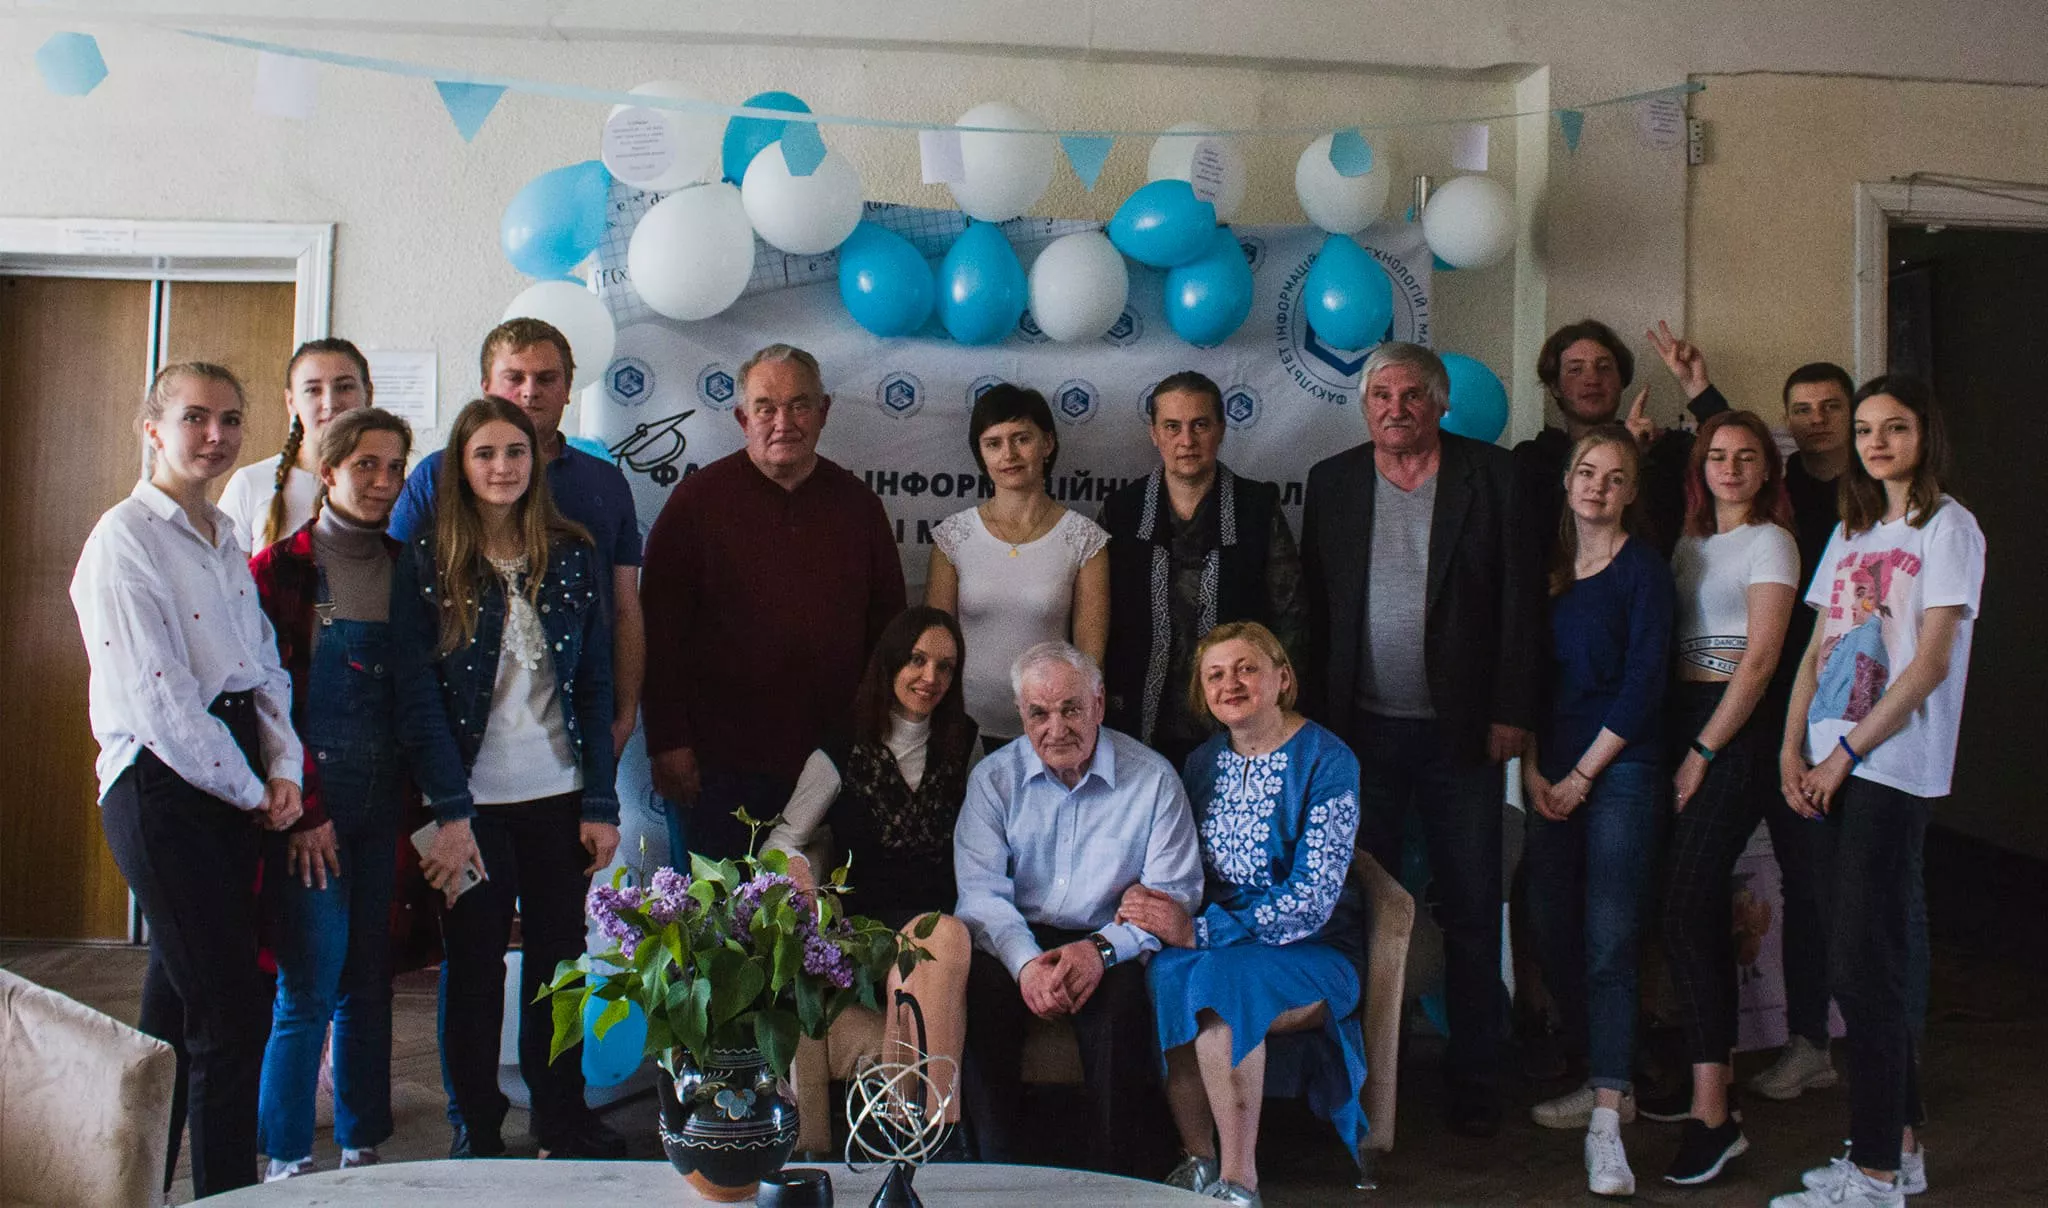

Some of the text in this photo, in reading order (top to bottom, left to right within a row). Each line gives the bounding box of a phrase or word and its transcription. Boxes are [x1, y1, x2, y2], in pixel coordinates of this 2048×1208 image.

[1279, 347, 1347, 405] ФАКУЛЬТЕТ
[1365, 247, 1428, 308] ХНОЛОГІЙ
[1718, 661, 1735, 671] KEE
